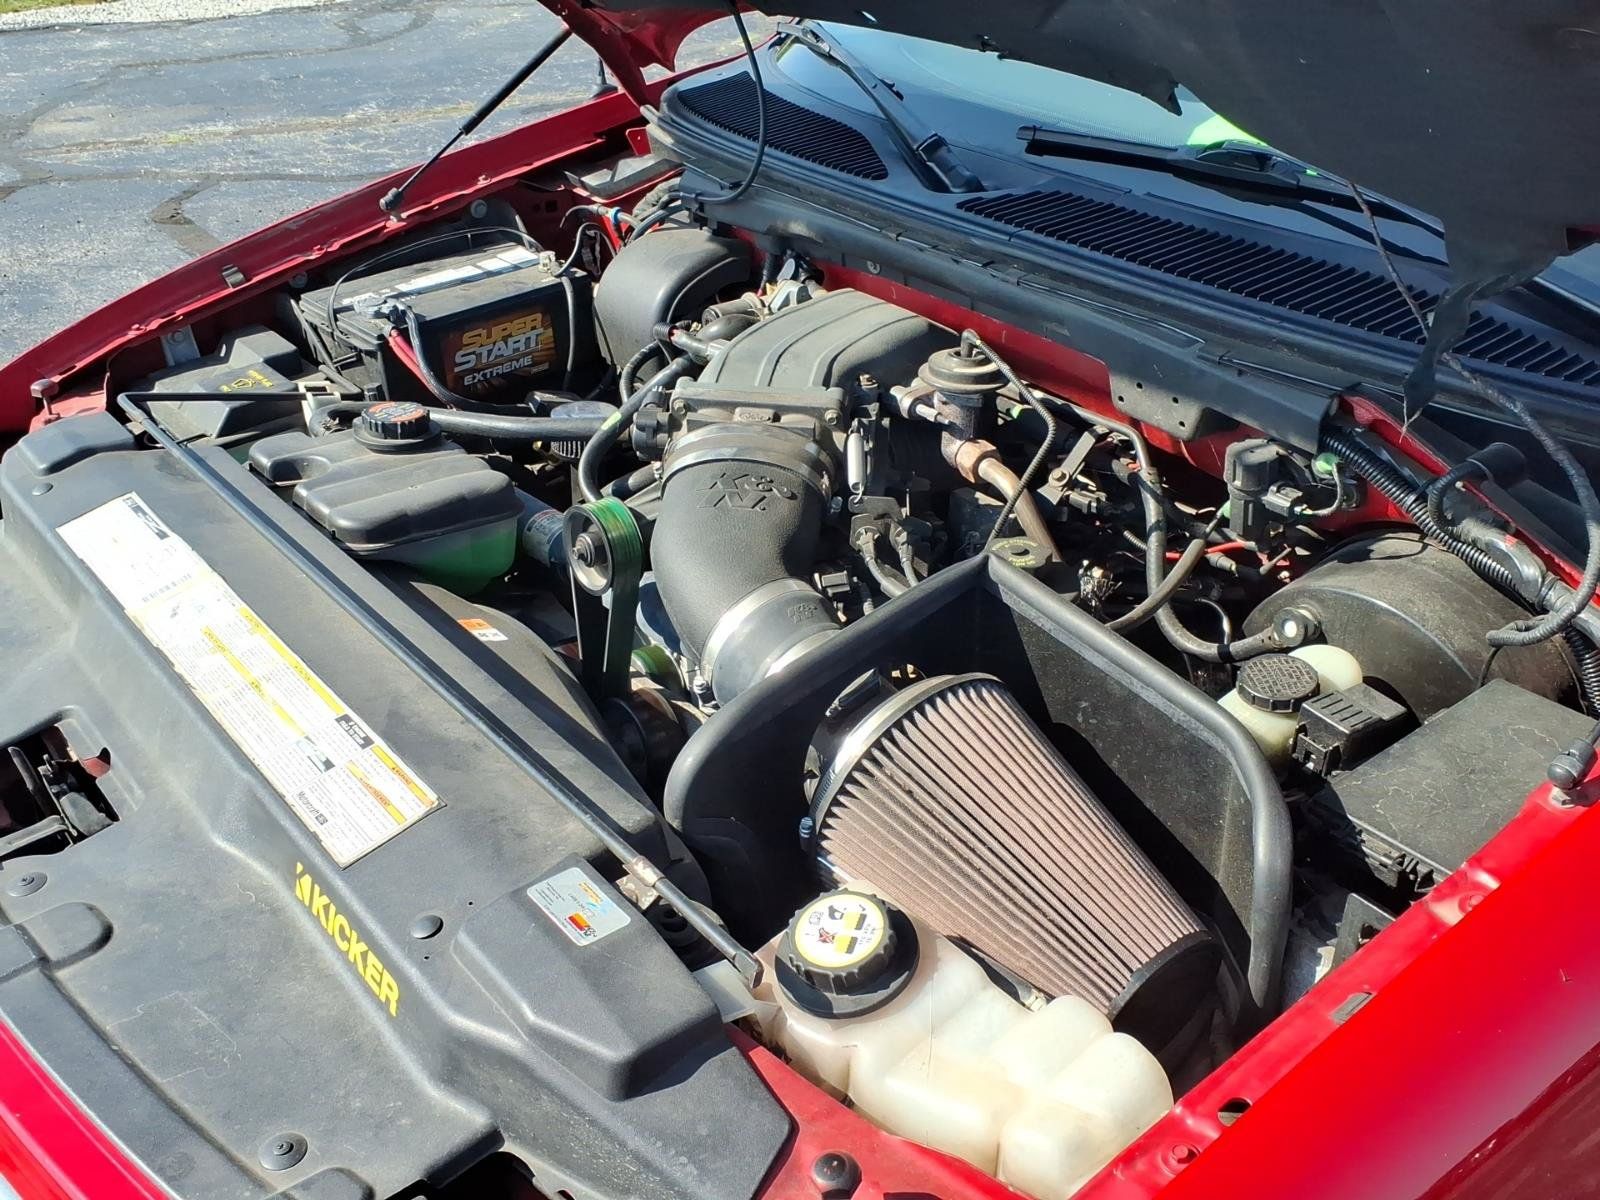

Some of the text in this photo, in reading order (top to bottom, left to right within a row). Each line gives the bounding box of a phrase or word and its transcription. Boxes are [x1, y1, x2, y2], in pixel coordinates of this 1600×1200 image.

[454, 328, 544, 373] START
[462, 312, 542, 351] SUPER
[464, 355, 533, 386] EXTREME
[311, 883, 399, 1017] KICKER
